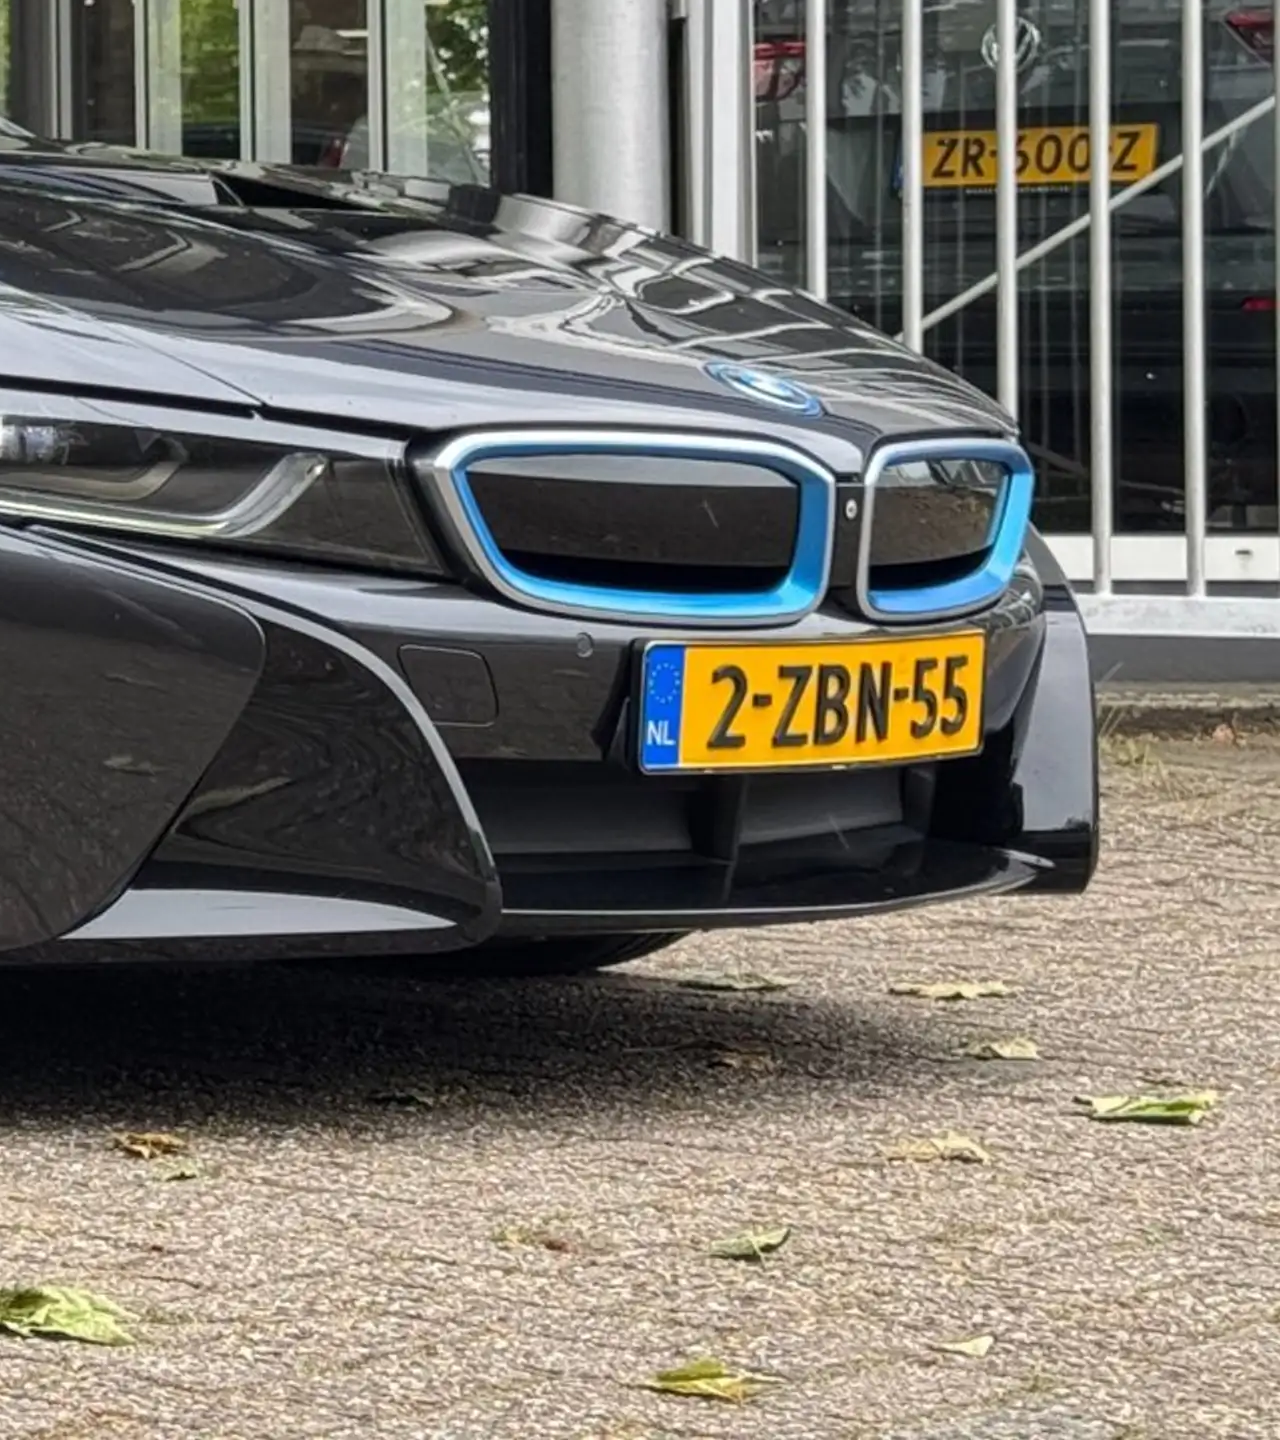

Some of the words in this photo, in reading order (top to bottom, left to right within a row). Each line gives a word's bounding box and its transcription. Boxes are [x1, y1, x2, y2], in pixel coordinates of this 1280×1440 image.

[931, 132, 1141, 178] ZR-600Z
[646, 719, 676, 746] NL
[706, 655, 969, 750] 2-ZBN-55
